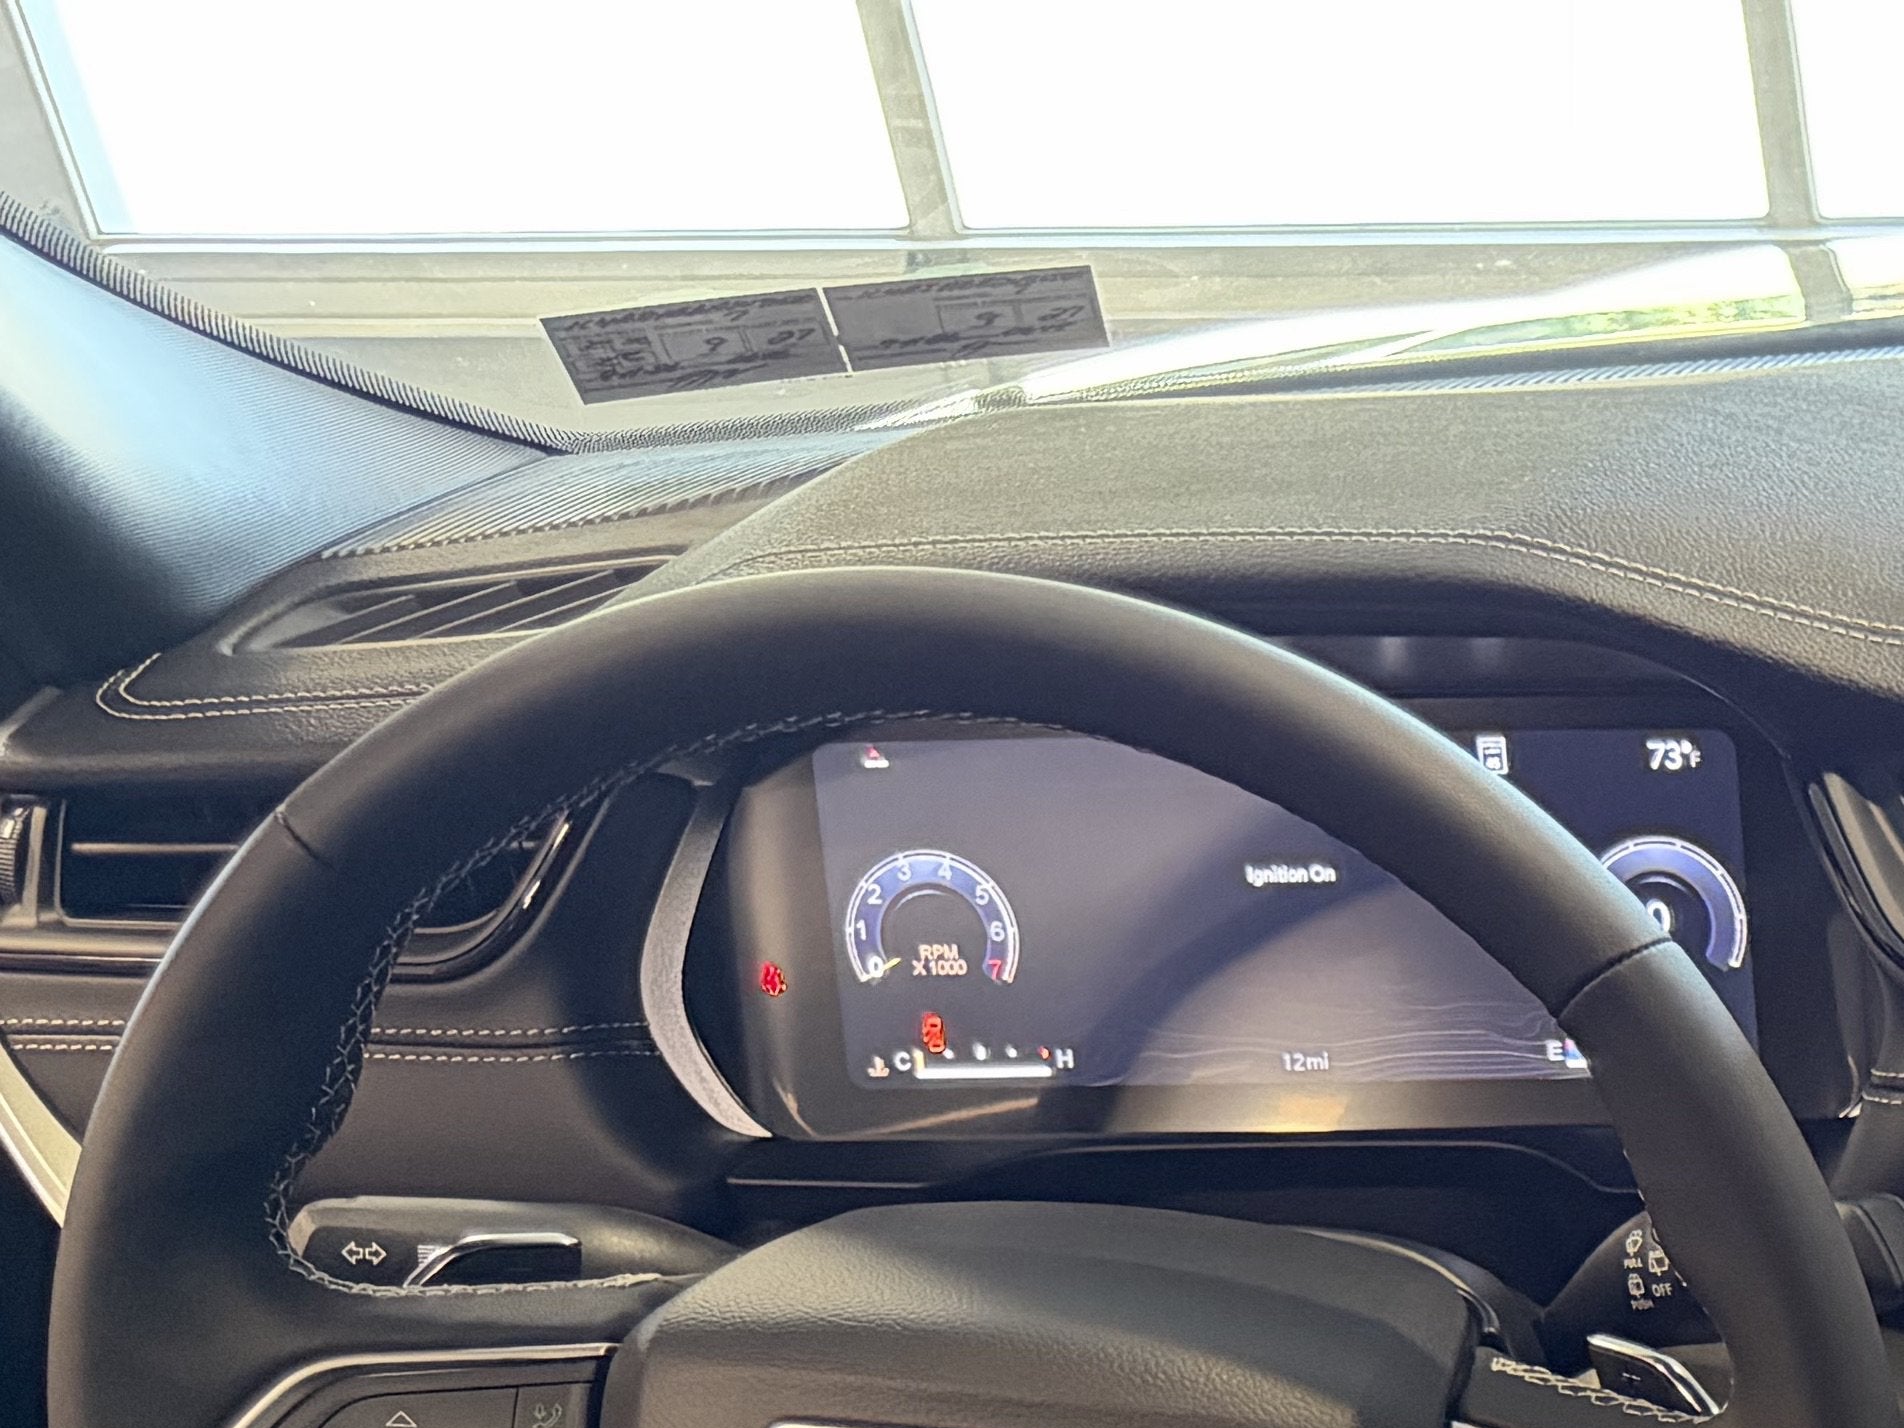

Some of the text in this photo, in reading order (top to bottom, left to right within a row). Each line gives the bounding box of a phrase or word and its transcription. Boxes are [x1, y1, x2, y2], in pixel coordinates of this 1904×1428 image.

[897, 861, 953, 881] 3 4
[1245, 863, 1337, 887] Ignition On
[867, 883, 990, 905] 2 5
[856, 920, 1005, 942] 1 6
[918, 944, 960, 960] RPM
[867, 956, 1001, 980] 0 7
[912, 959, 968, 976] X 1000
[893, 1048, 1074, 1072] C H
[1546, 1039, 1563, 1061] E
[1652, 1283, 1673, 1297] OFF
